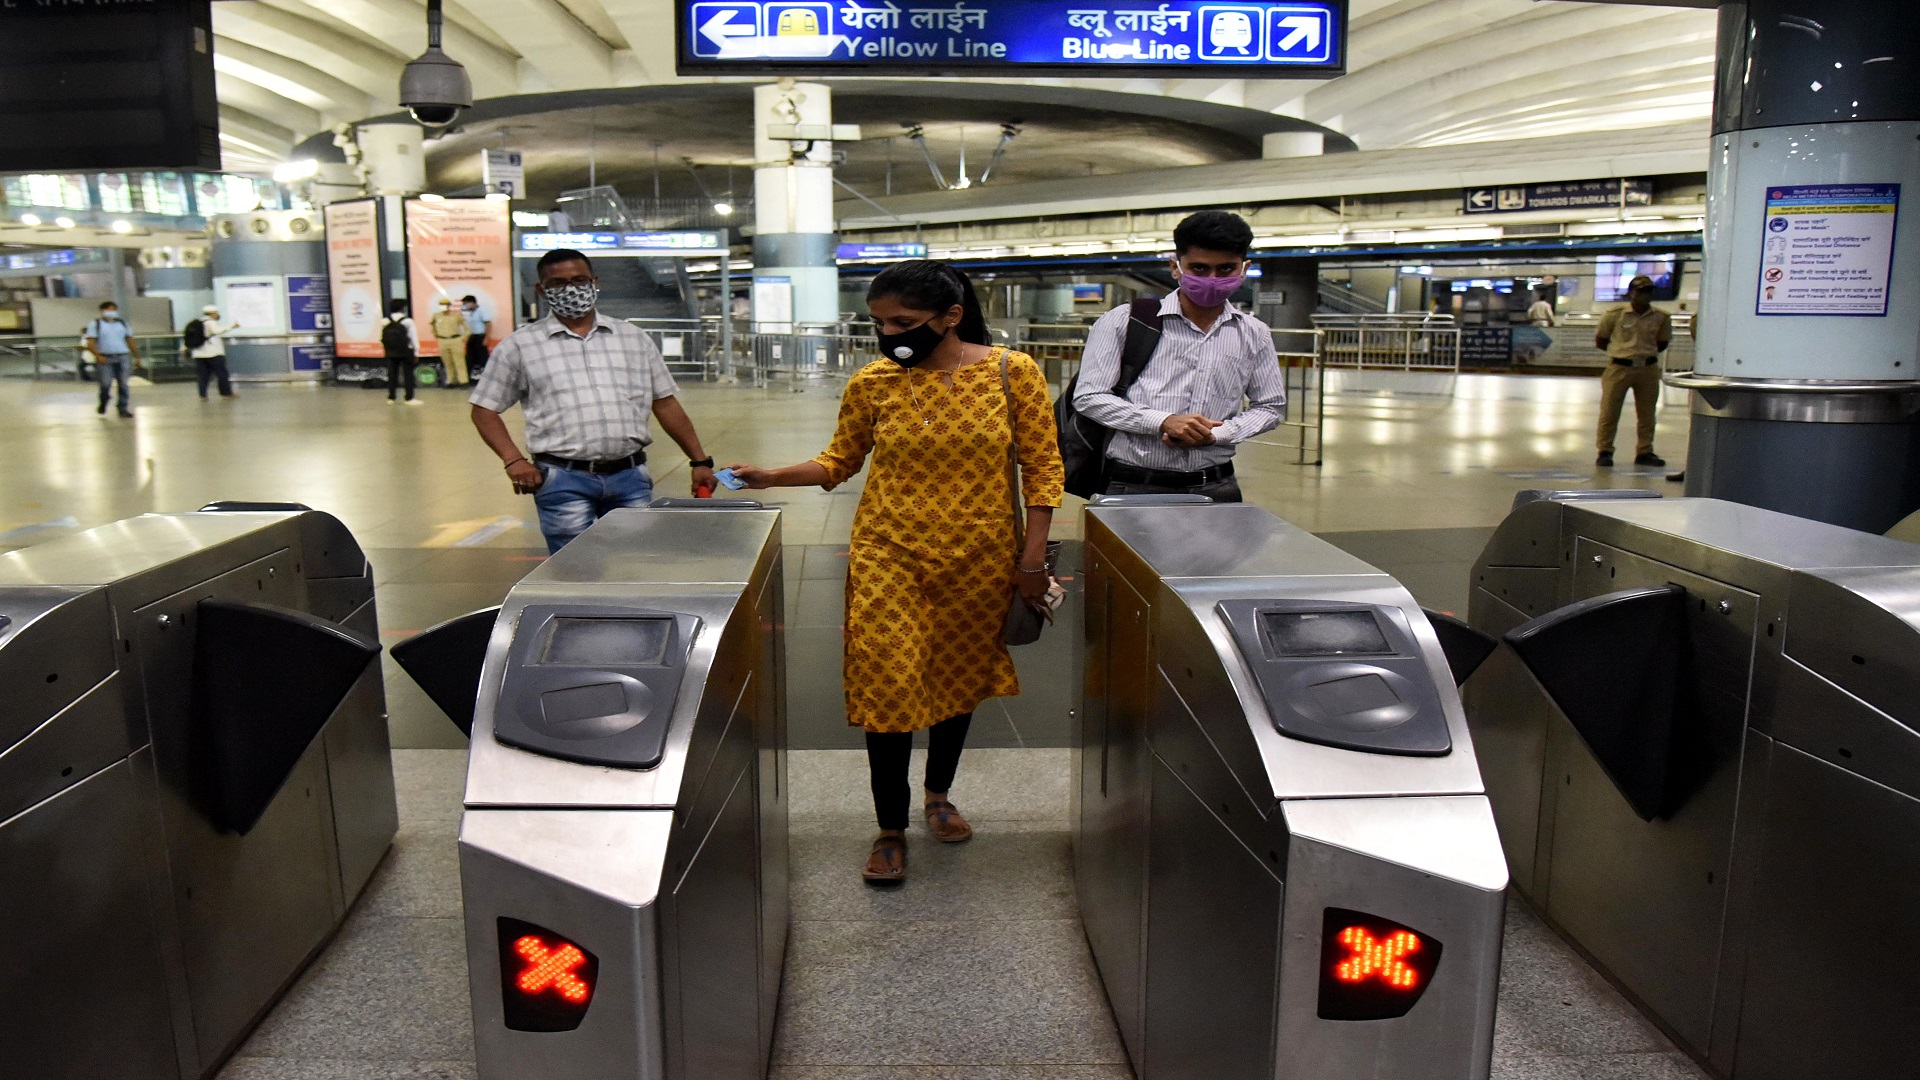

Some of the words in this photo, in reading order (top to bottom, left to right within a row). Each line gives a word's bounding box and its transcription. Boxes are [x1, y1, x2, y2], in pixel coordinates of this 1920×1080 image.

[840, 0, 902, 29] येलो
[909, 2, 988, 33] लाईन
[1067, 10, 1113, 37] ब्लू
[1113, 4, 1191, 36] लाईन
[844, 37, 938, 57] Yellow
[948, 38, 1007, 57] Line
[1063, 38, 1124, 59] Blue
[1132, 38, 1191, 60] Line
